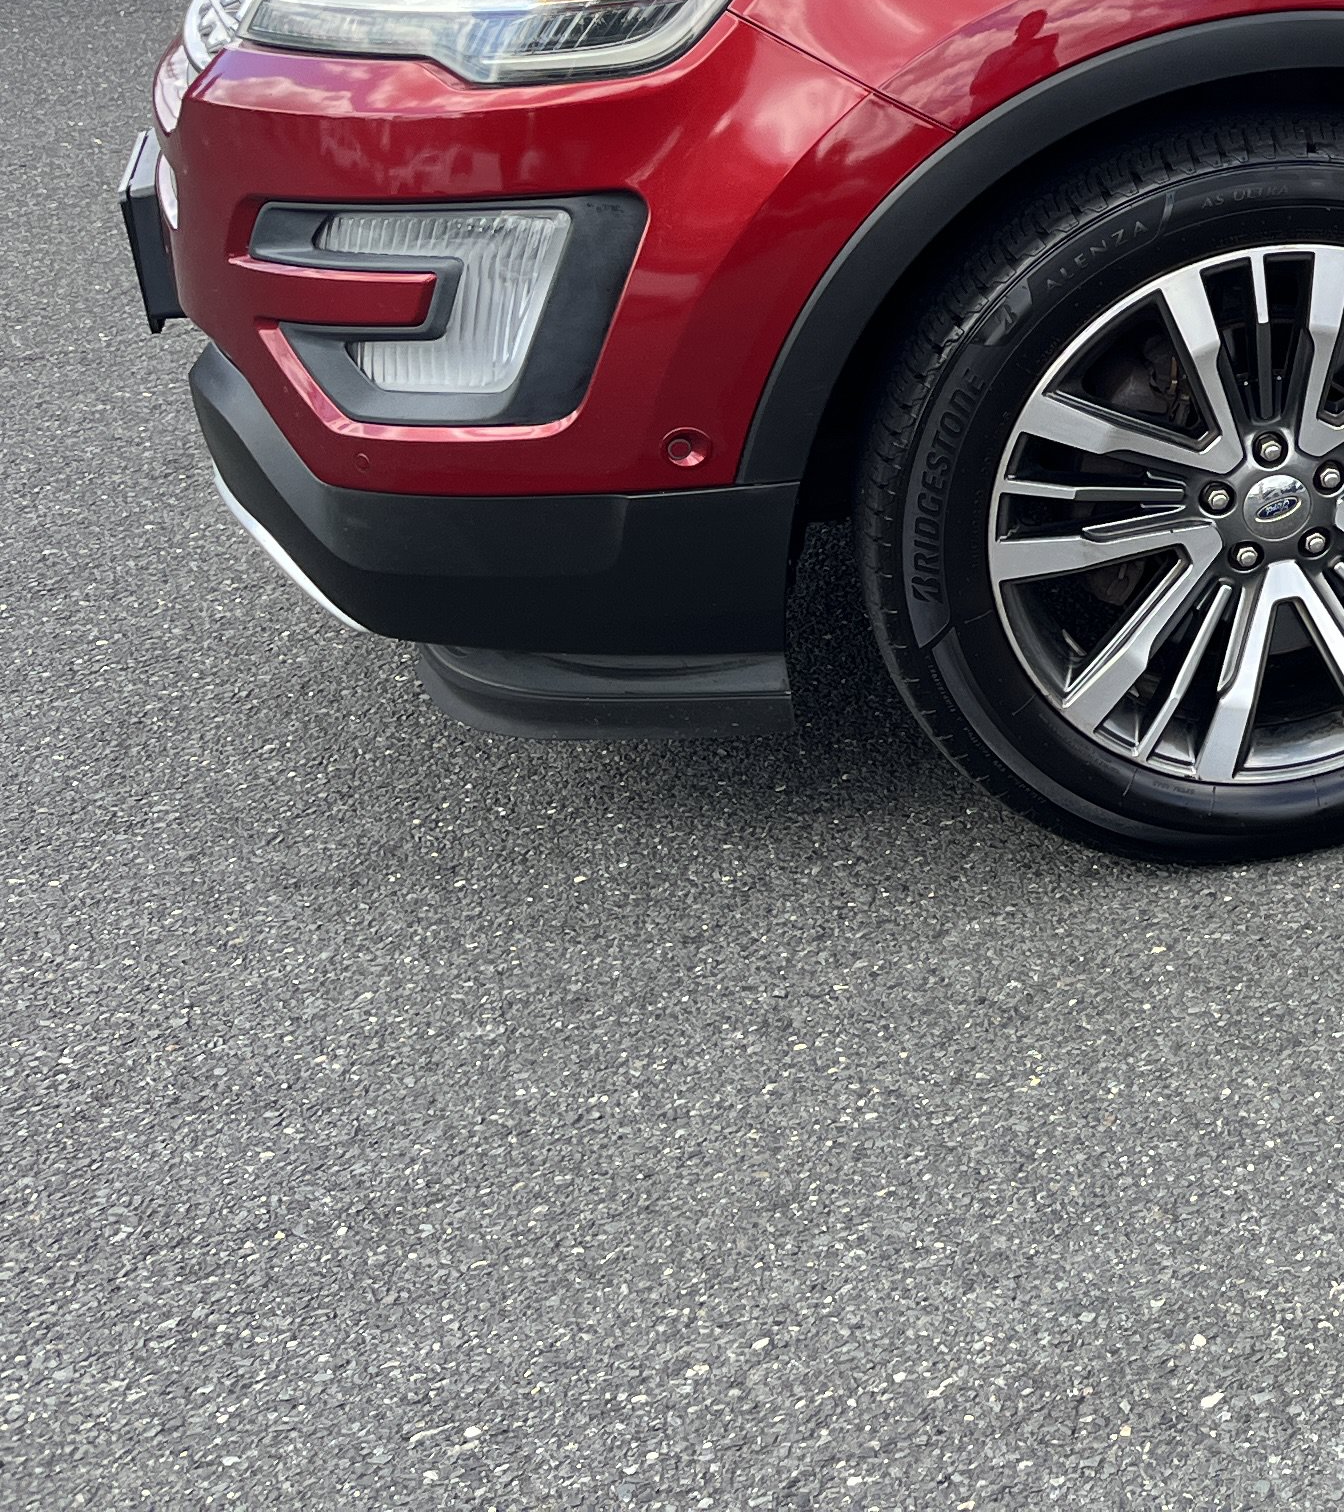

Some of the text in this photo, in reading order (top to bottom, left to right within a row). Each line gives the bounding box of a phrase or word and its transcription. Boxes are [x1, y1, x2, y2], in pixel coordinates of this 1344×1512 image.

[1201, 183, 1289, 208] AS ULTRA
[911, 367, 986, 604] BRIDGESTONE
[1045, 219, 1149, 292] ALENZA
